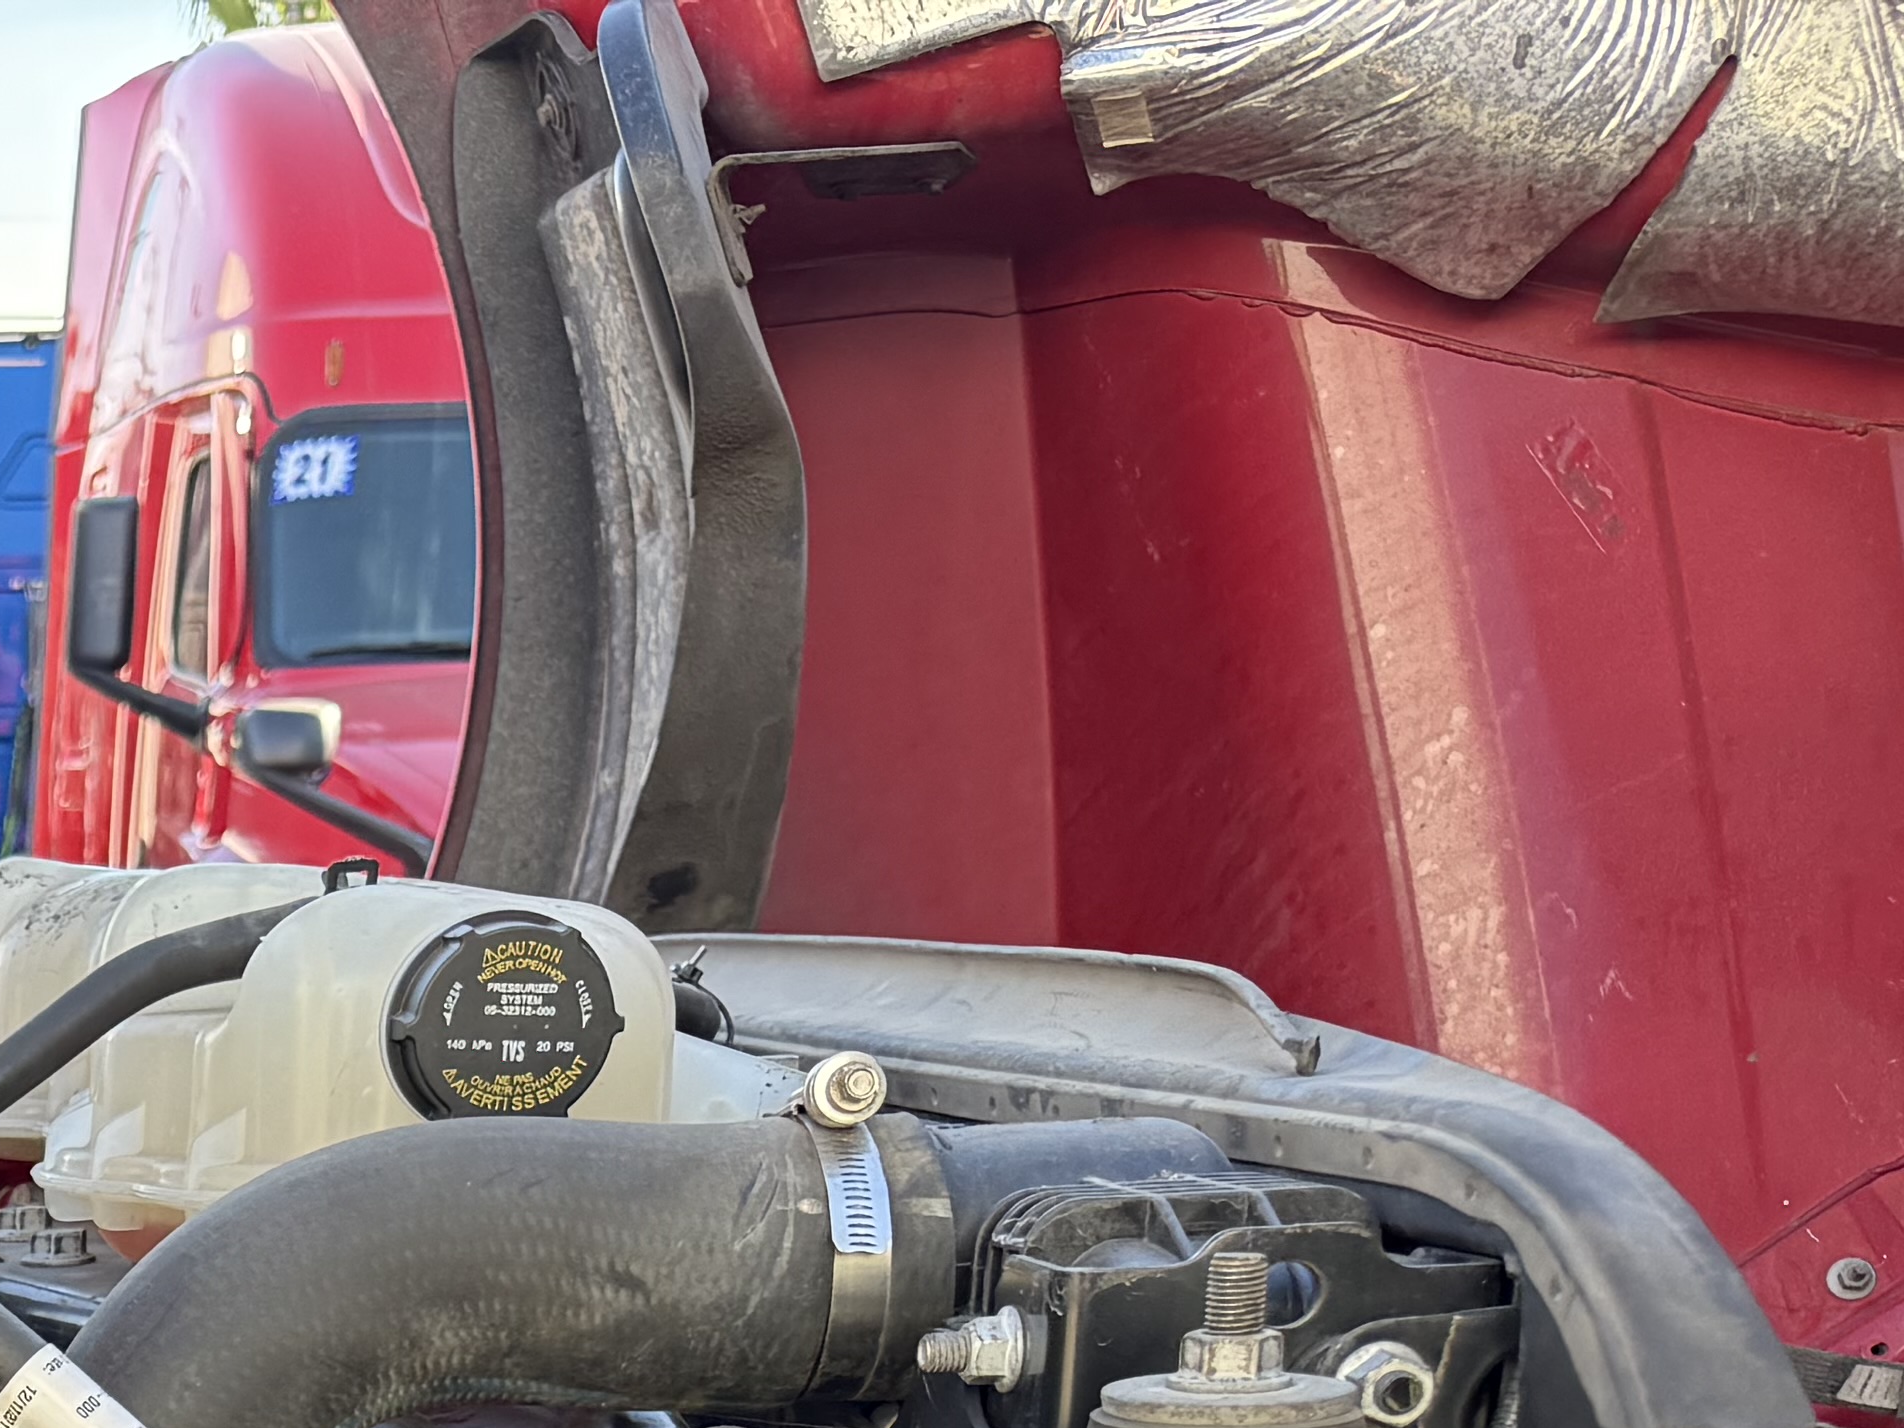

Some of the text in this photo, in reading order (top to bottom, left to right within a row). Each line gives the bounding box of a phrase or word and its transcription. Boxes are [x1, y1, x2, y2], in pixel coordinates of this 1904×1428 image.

[497, 940, 564, 964] CAUTION
[476, 959, 514, 984] NEVER
[515, 957, 549, 976] OPEN
[486, 982, 559, 994] PRESSURIZED
[500, 995, 544, 1006] SYSTEM
[446, 1039, 467, 1050] 140
[501, 1039, 527, 1063] TVS
[536, 1041, 551, 1053] 20
[555, 1041, 575, 1053] PSI
[494, 1074, 512, 1086] NE
[523, 1065, 562, 1094] CHAUD
